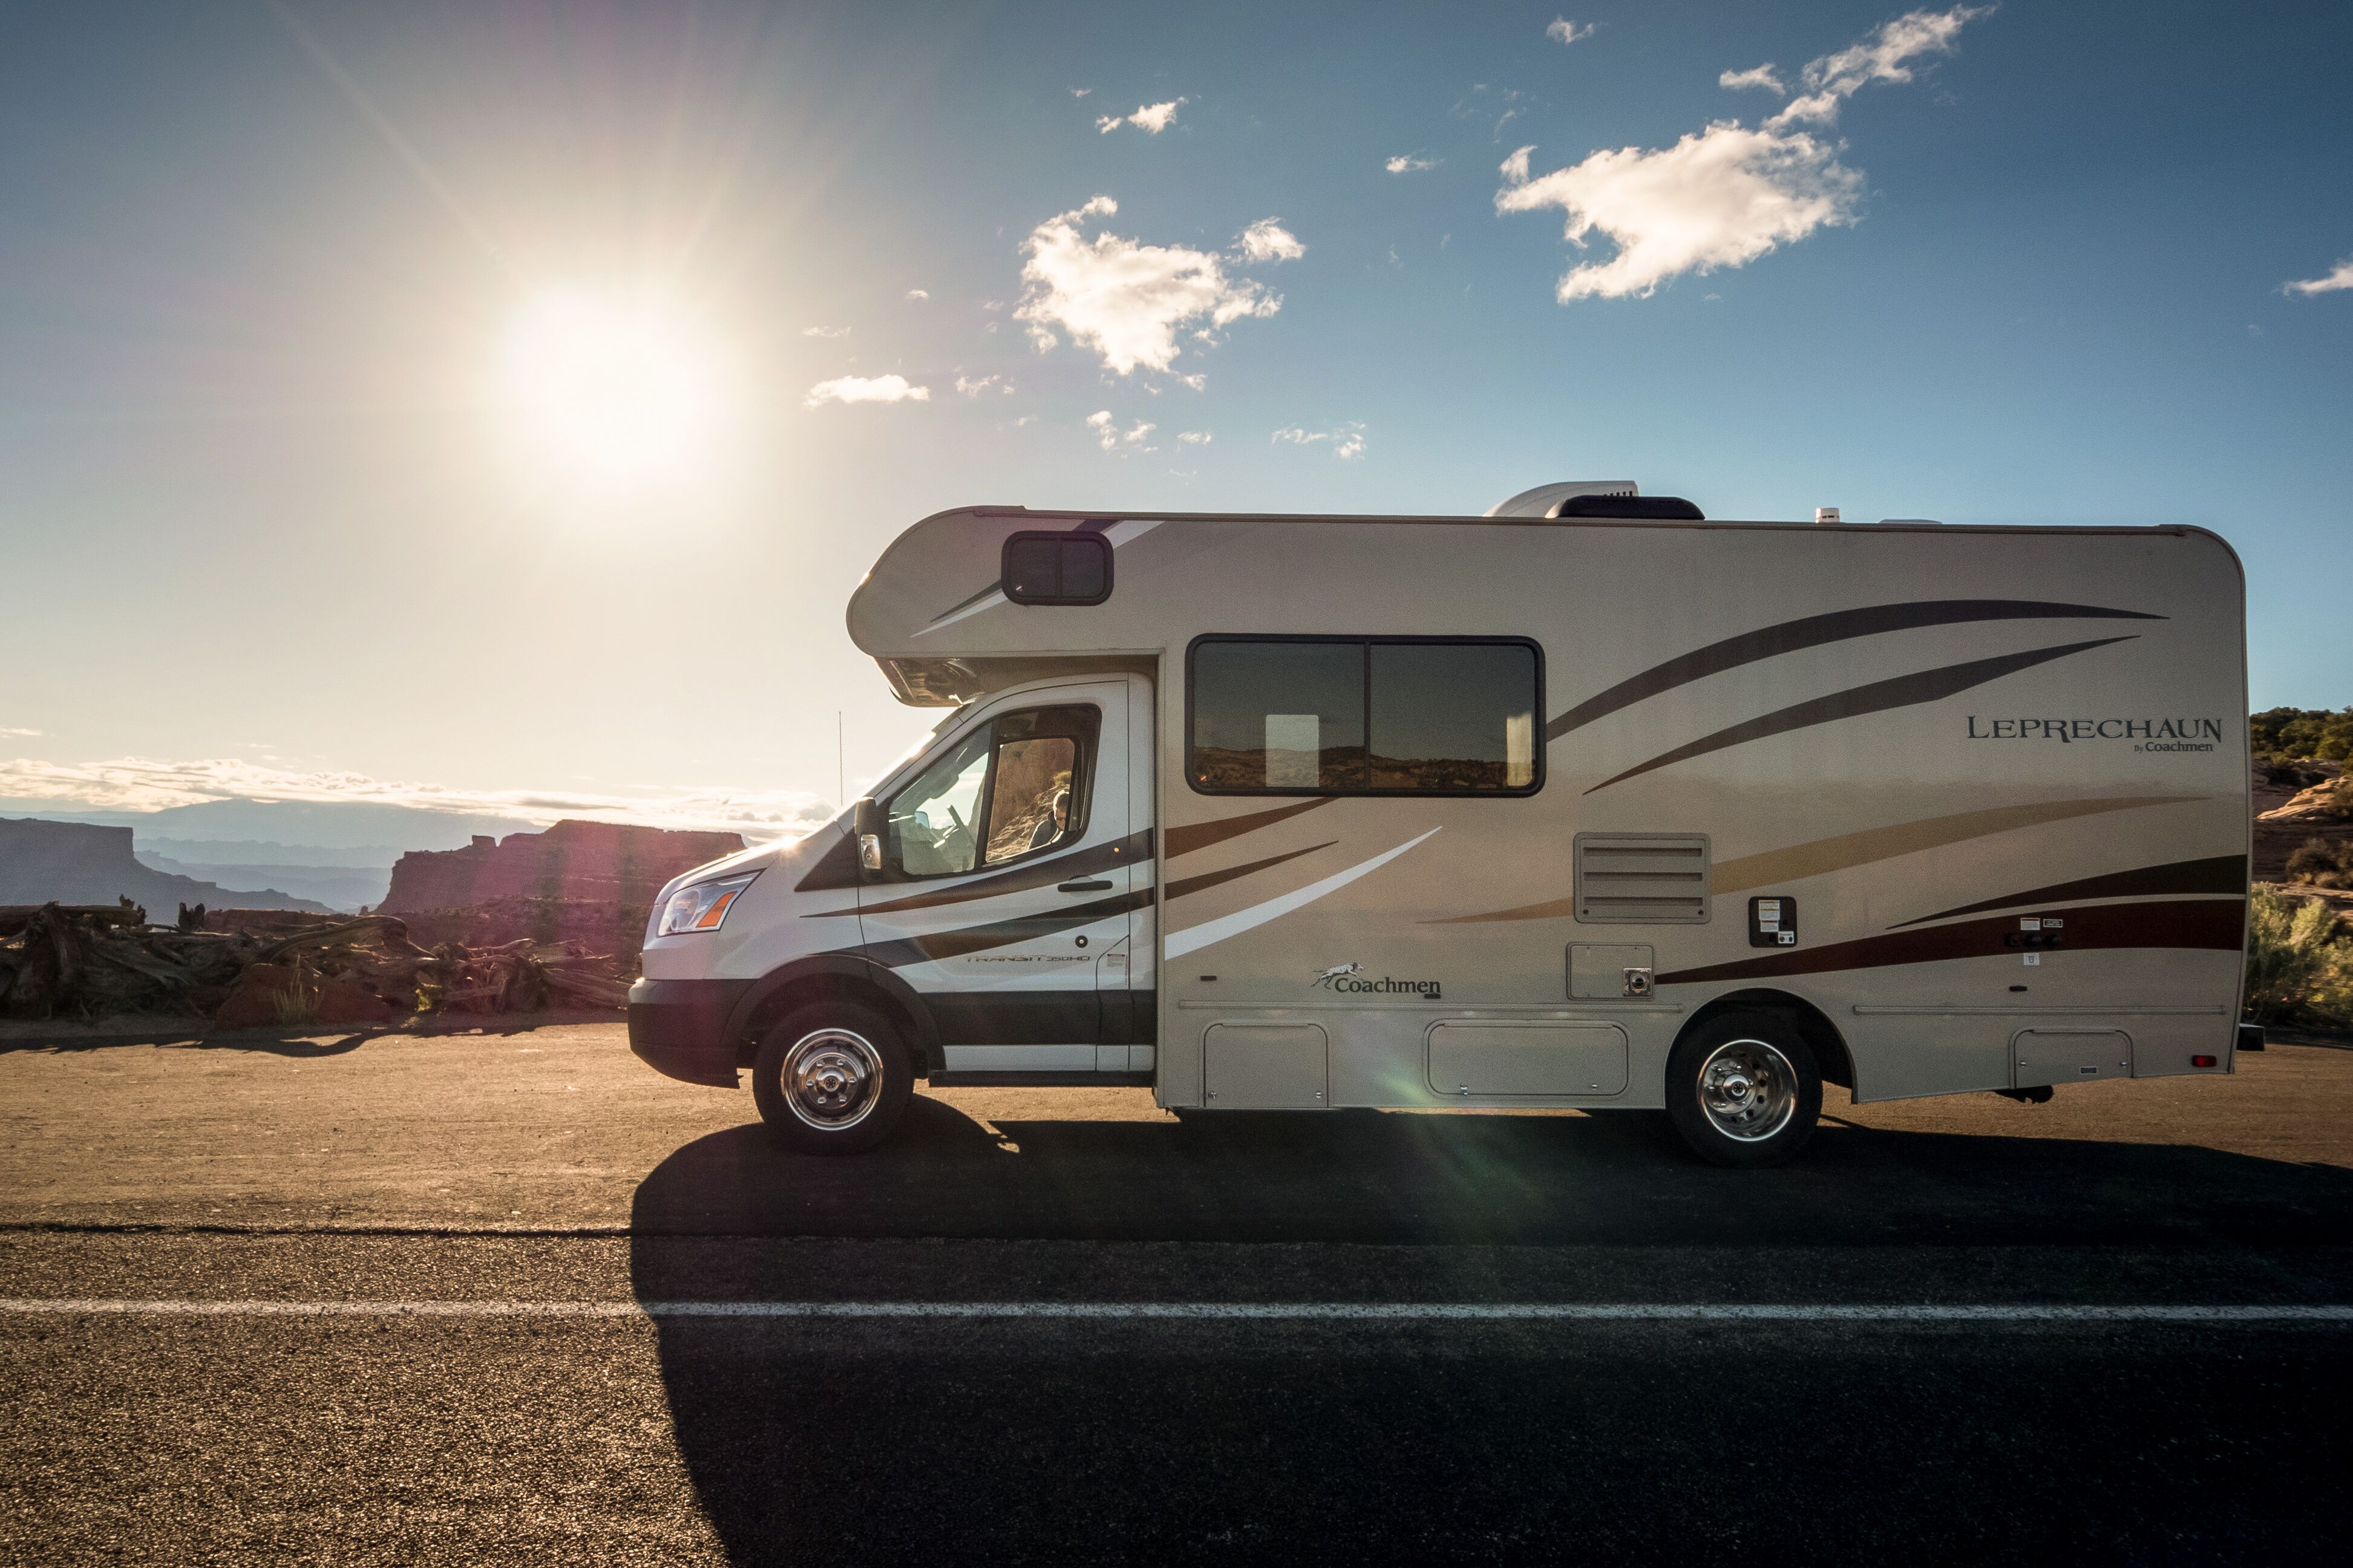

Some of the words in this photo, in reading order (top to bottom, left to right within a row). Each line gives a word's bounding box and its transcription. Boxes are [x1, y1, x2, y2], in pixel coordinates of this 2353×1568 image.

[1967, 715, 2222, 743] LEPRECHAUN
[2145, 742, 2213, 752] Coachmen
[1335, 976, 1441, 993] Coachmen
